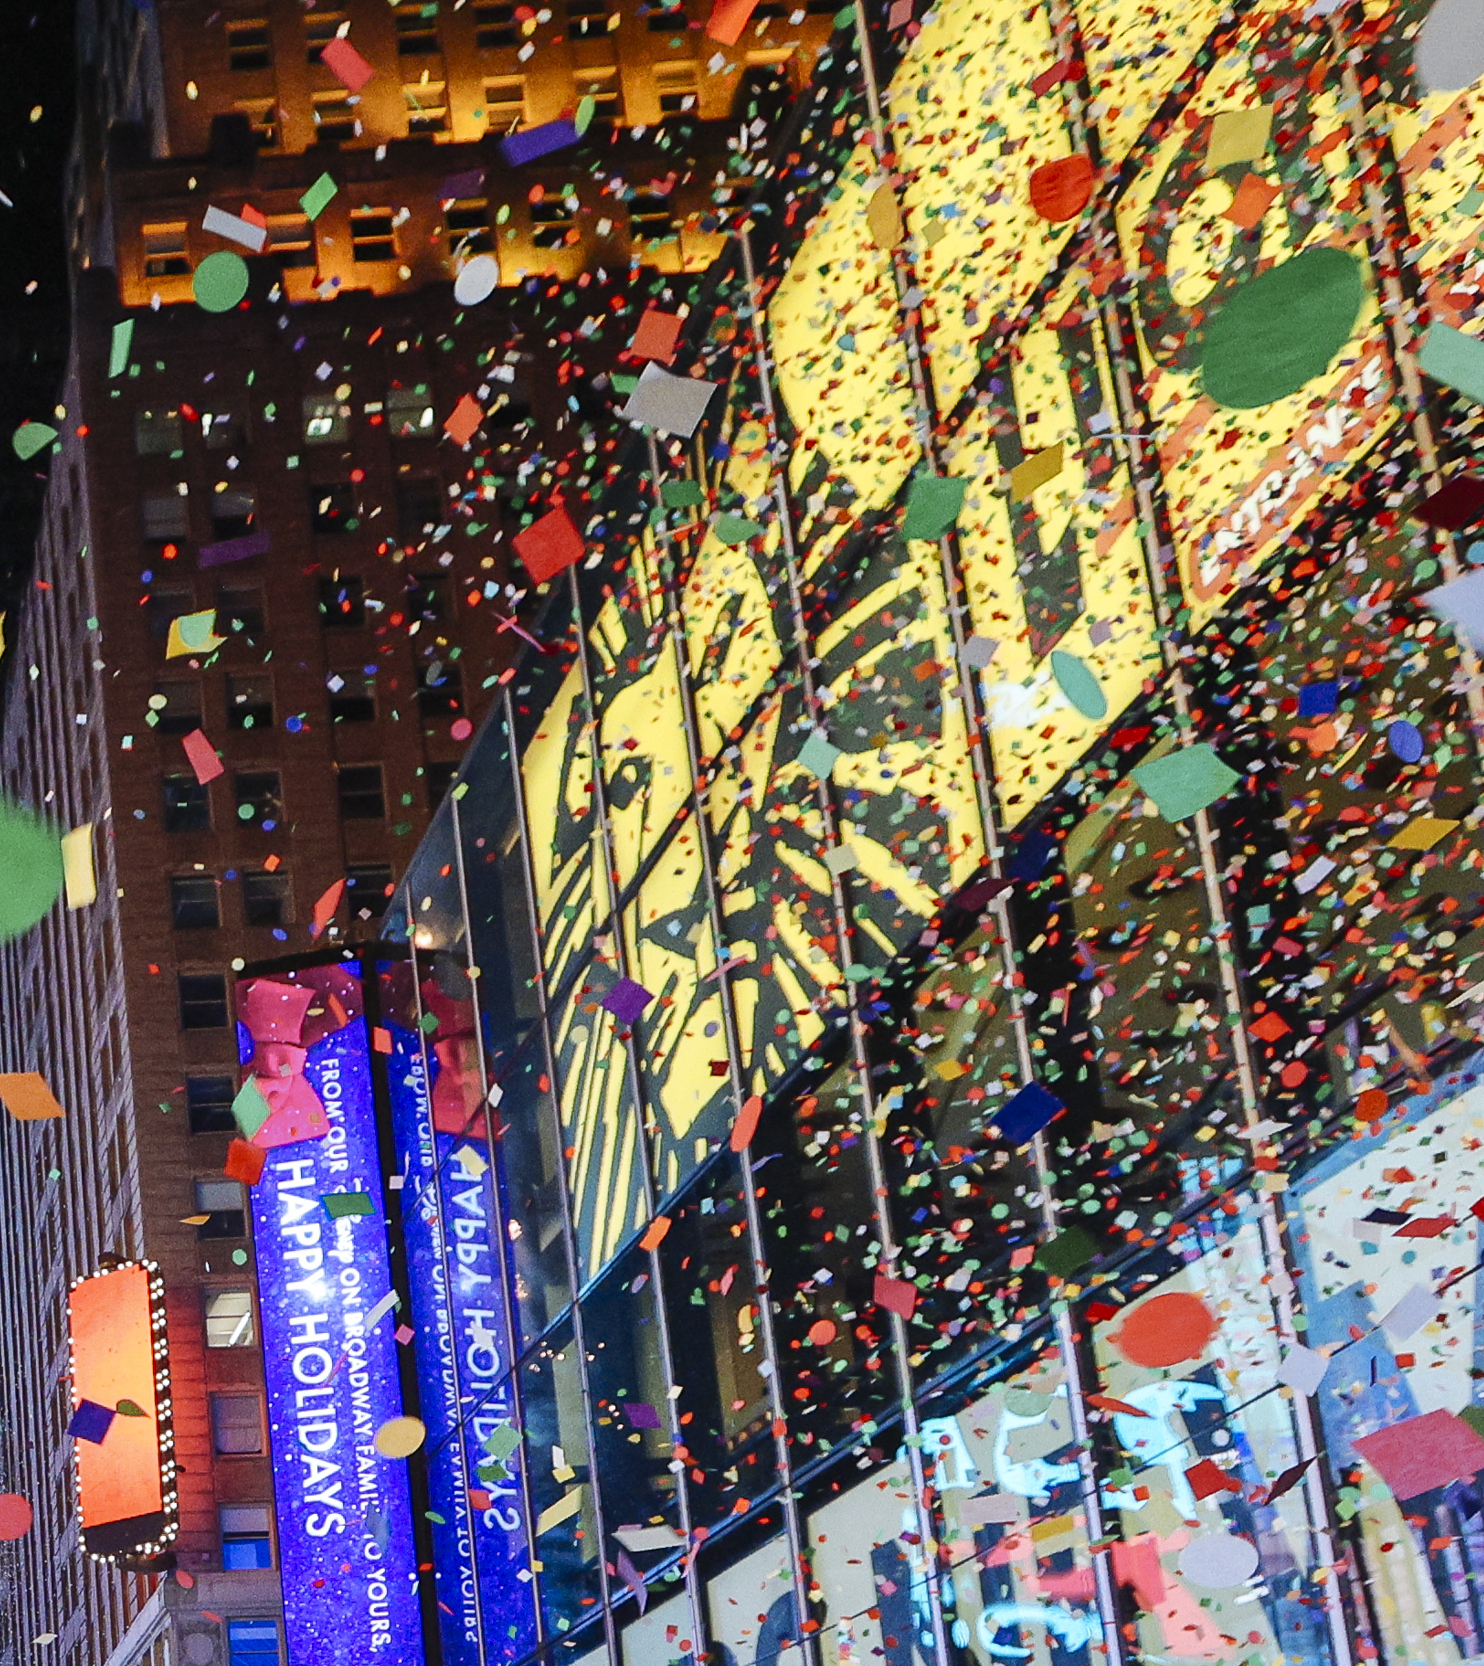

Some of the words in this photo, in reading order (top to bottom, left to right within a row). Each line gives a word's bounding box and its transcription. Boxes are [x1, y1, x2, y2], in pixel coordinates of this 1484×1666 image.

[321, 1058, 343, 1118] FROM
[327, 1128, 349, 1173] OUR
[276, 1159, 334, 1300] HAPPY
[339, 1268, 361, 1305] ON
[344, 1312, 373, 1436] BROADWAY
[288, 1315, 346, 1539] HOLIDAYS
[366, 1568, 390, 1653] YOURS,
